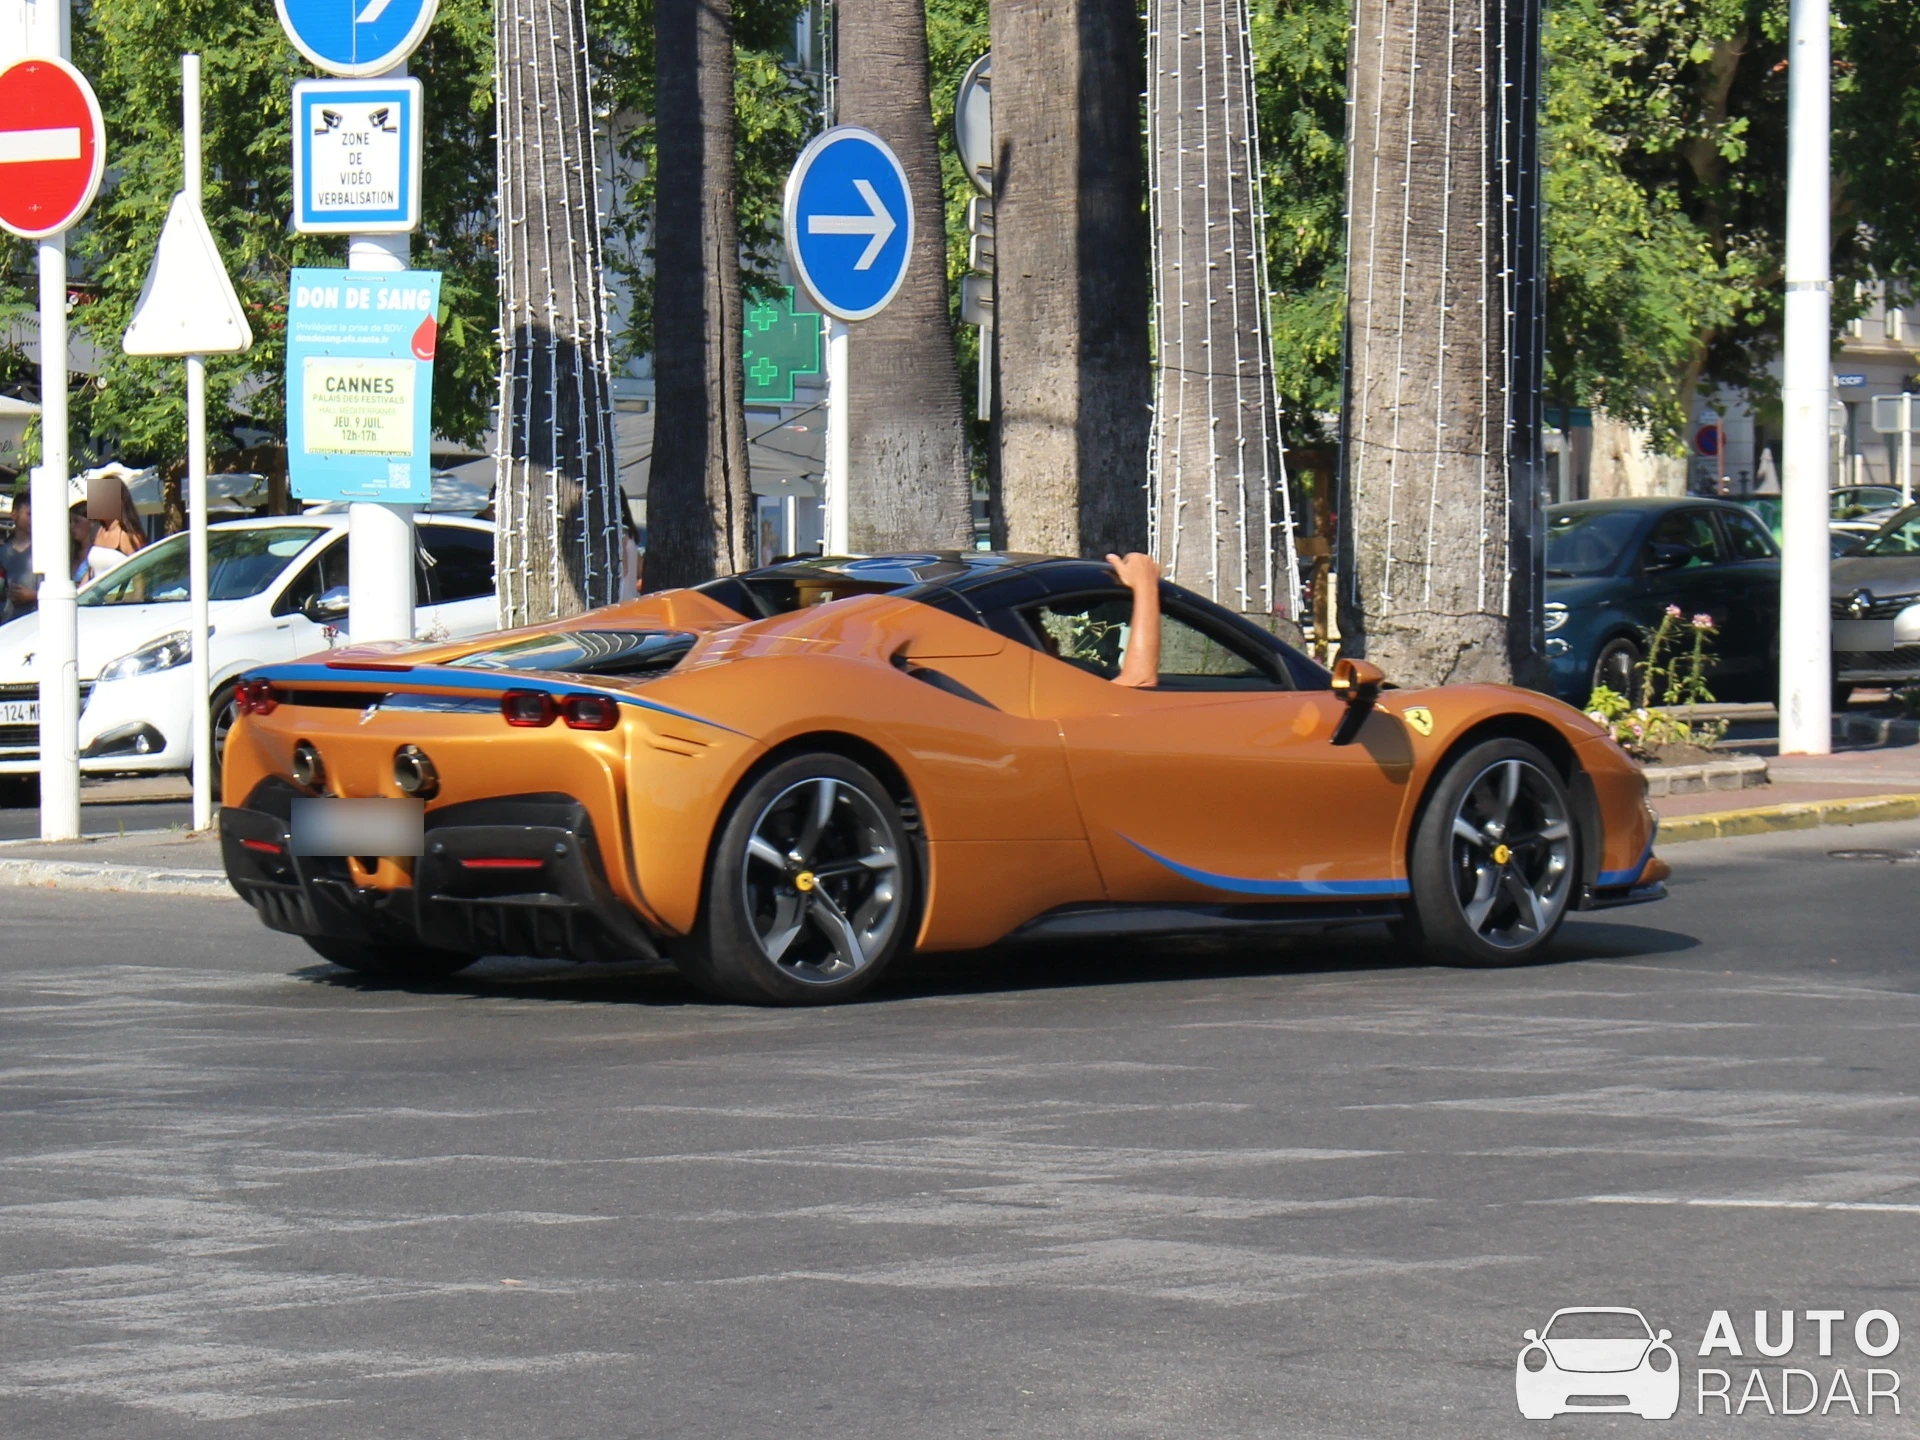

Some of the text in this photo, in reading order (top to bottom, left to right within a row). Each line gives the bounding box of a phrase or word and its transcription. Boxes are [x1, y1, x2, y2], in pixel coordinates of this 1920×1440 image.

[341, 132, 370, 146] ZONE
[349, 152, 362, 165] DE
[340, 169, 372, 185] VIDÉO
[318, 190, 394, 205] VERBALISATION
[296, 286, 431, 311] DON DE SANG
[296, 321, 338, 333] Privilégiez
[339, 322, 346, 332] la
[348, 323, 369, 333] prise
[370, 323, 382, 332] de
[295, 333, 389, 344] dondesang.efs.sante.fr
[325, 376, 395, 394] CANNES
[312, 393, 405, 404] PALAIS DES FESTIVALS
[319, 406, 337, 414] HALL
[333, 416, 385, 429] JEU. 9 JUIL.
[341, 429, 377, 442] 12h-17h
